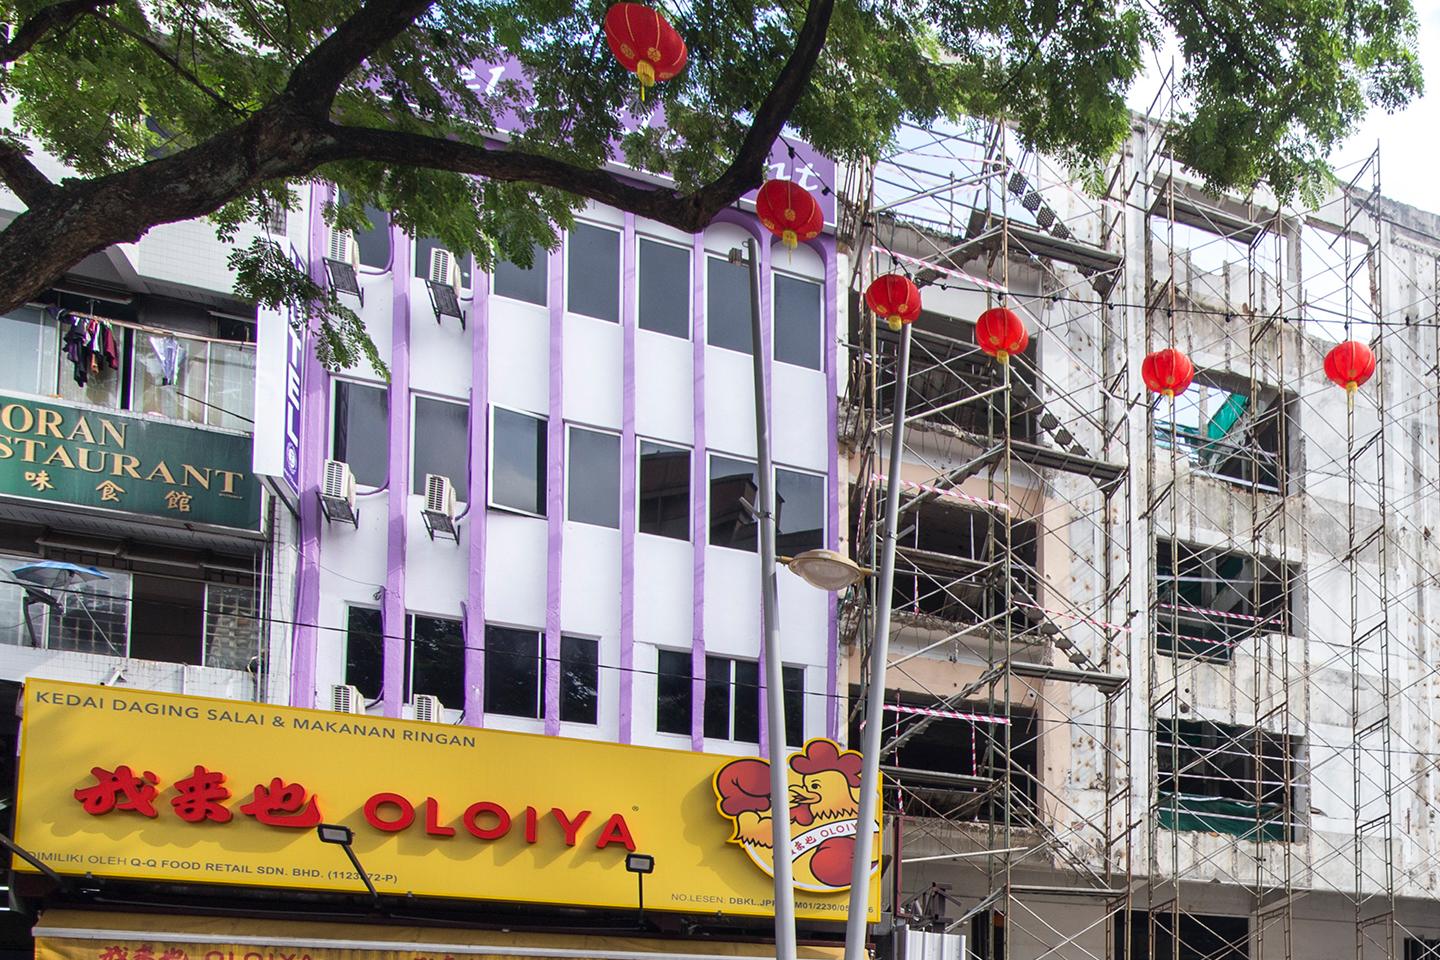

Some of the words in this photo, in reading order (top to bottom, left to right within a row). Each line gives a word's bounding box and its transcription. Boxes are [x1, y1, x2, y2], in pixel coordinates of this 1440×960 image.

[36, 691, 104, 709] KEDAI
[112, 699, 200, 720] DAGING
[207, 708, 265, 726] SALAI
[272, 714, 286, 728] &
[293, 717, 396, 740] MAKANAN
[402, 728, 477, 749] RINGAN
[363, 792, 637, 852] OLOIYA
[791, 835, 817, 856] 来也
[88, 855, 127, 865] OLEH
[130, 858, 157, 868] Q-Q
[161, 860, 201, 870] FOOD
[205, 863, 252, 874] RETAIL
[257, 866, 287, 877] SDN.
[292, 868, 323, 879] BHD.
[327, 871, 398, 884] (112372-P)
